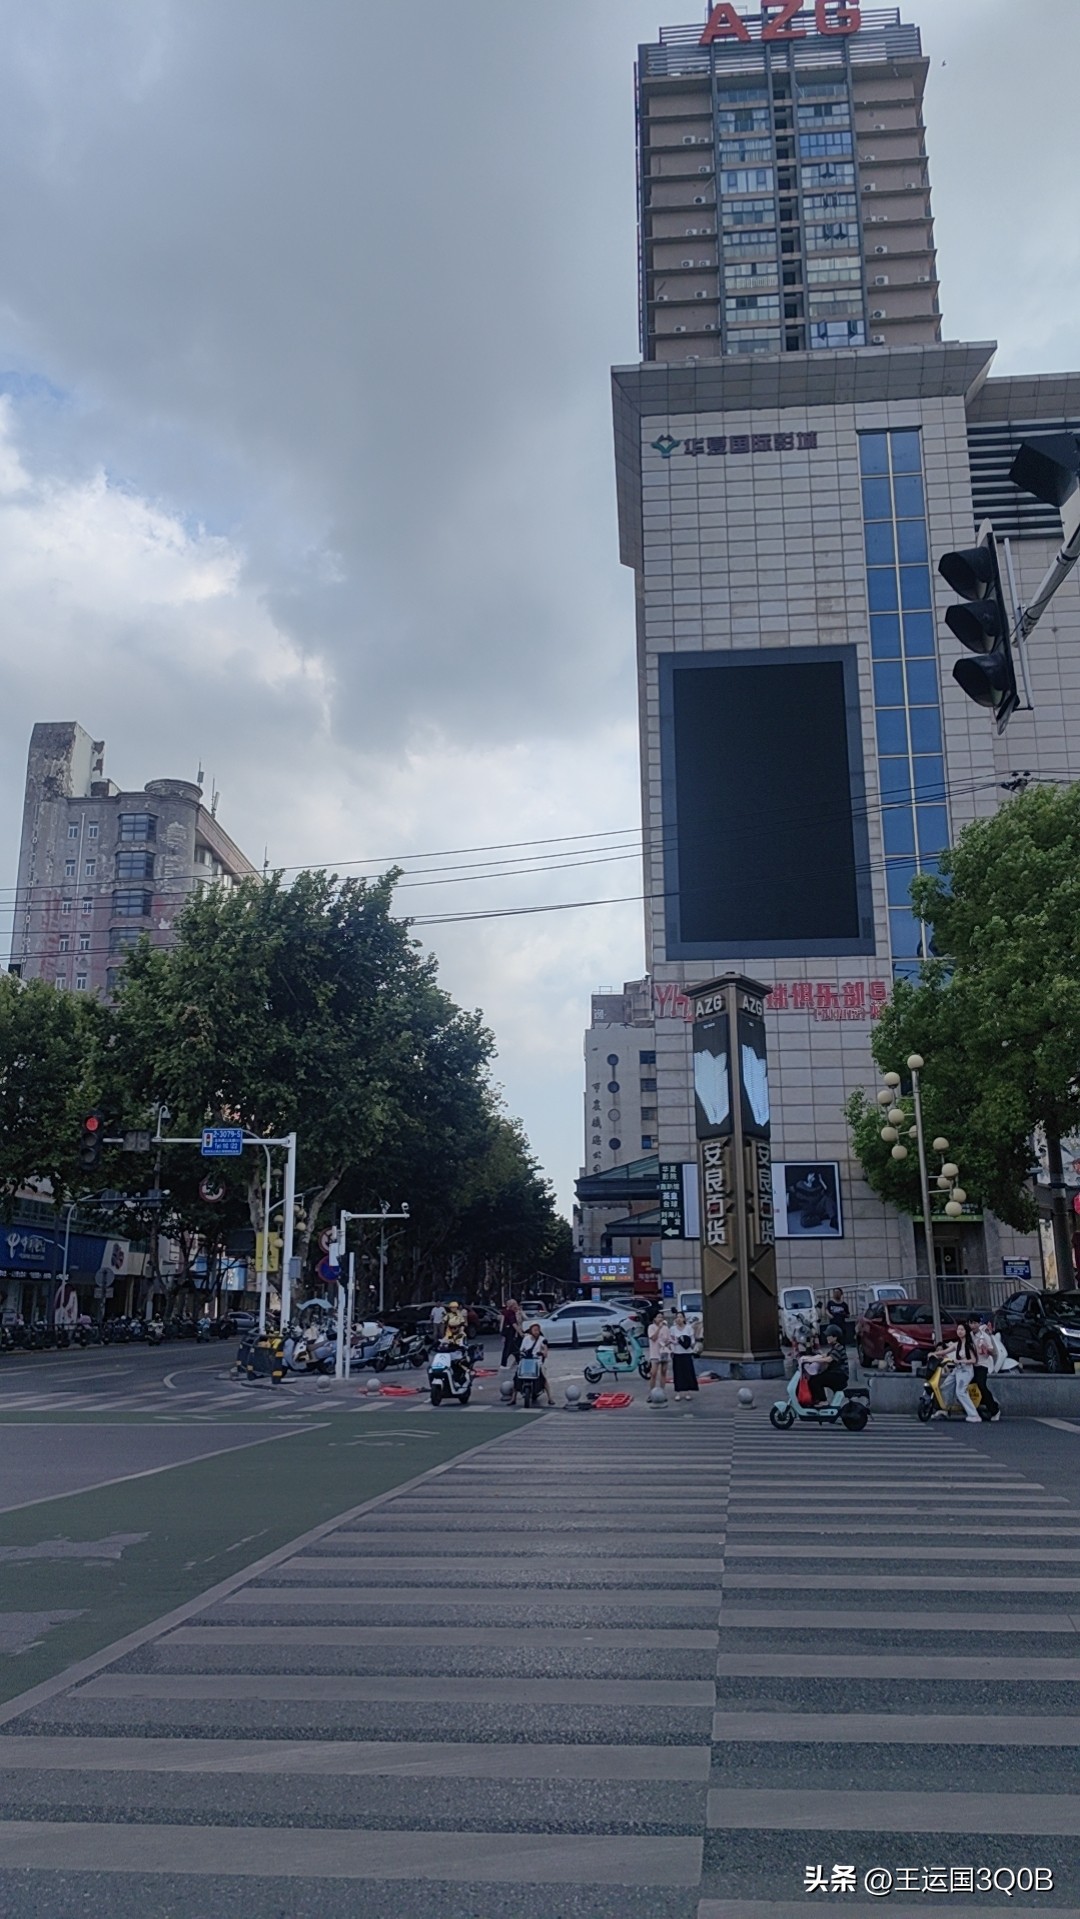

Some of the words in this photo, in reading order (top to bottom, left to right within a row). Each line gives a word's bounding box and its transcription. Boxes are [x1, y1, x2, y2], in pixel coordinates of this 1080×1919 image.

[698, 0, 862, 46] AZG
[683, 431, 818, 457] 华夏国际影城
[696, 994, 723, 1016] AZG
[742, 994, 763, 1017] AZG
[663, 1200, 678, 1208] 台球
[704, 1143, 727, 1246] 安良百货
[757, 1142, 774, 1246] 安良百货
[587, 1265, 627, 1274] 电玩巴士
